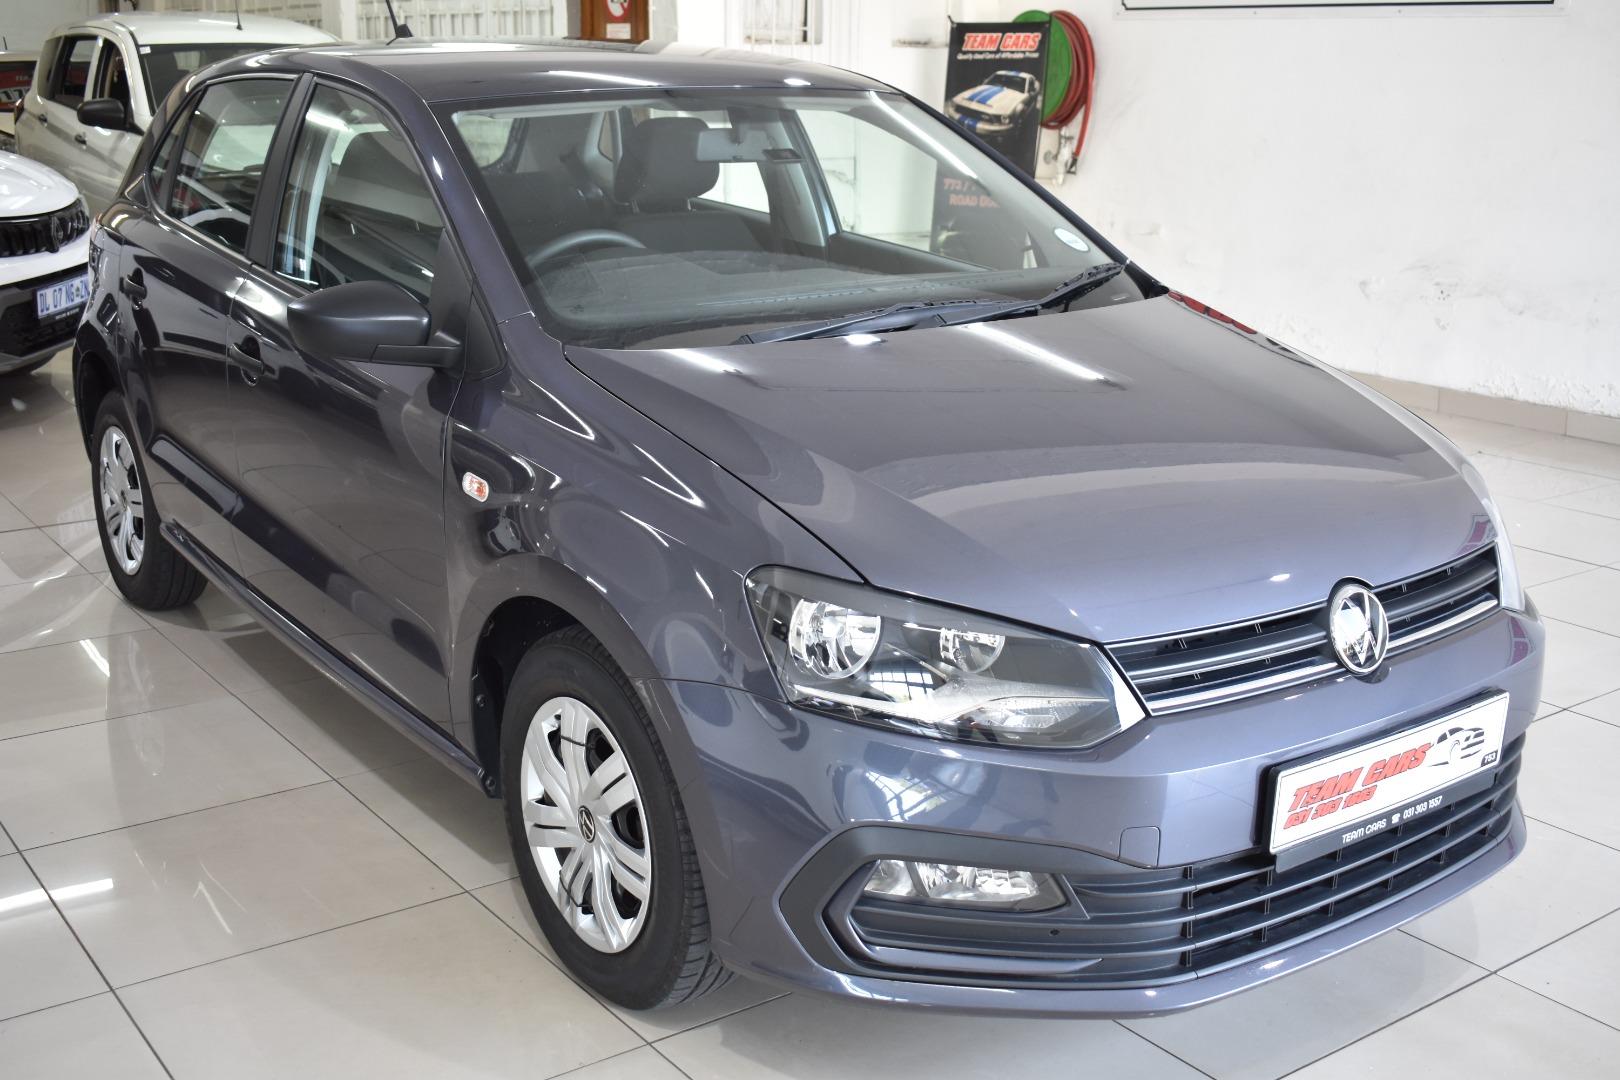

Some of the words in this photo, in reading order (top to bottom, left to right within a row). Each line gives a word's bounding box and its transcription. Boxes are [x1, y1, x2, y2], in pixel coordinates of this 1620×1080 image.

[962, 33, 1003, 51] TEAM
[1000, 33, 1042, 51] CARS
[949, 193, 977, 206] ROAD
[40, 292, 51, 312] DL
[53, 286, 63, 308] 07
[1484, 752, 1496, 764] 753
[1288, 766, 1364, 813] TEAM
[1362, 742, 1433, 787] CARS
[1341, 827, 1365, 844] TEAM
[1365, 818, 1387, 835] CARS
[1402, 809, 1415, 820] 031
[1414, 802, 1428, 817] 303
[1428, 795, 1443, 809] 1557
